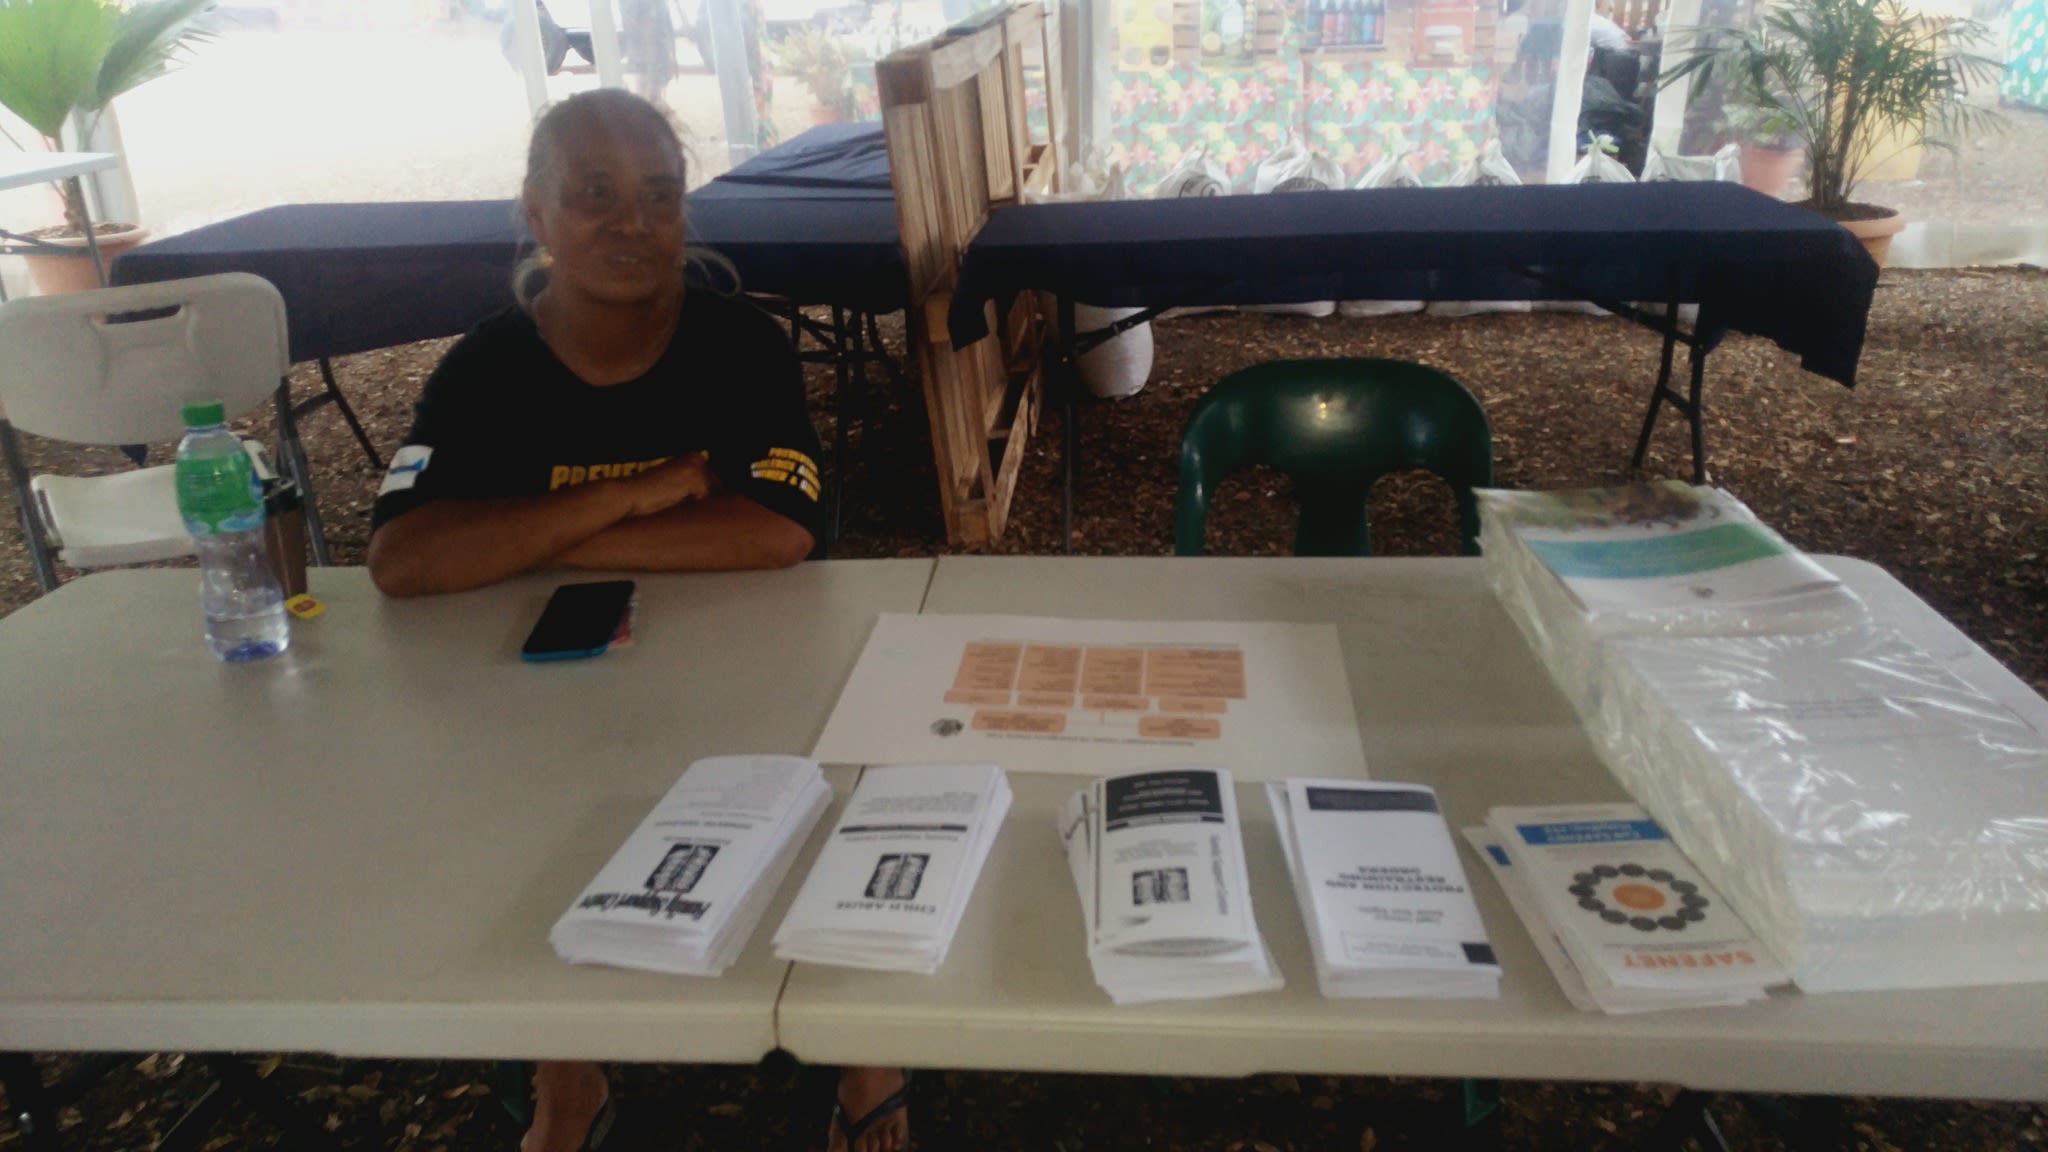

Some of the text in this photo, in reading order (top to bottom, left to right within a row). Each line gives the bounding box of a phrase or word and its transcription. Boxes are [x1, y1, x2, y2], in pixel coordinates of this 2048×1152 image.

[1362, 882, 1465, 894] PROTECTION
[613, 889, 670, 917] Support
[665, 892, 713, 922] Family
[836, 901, 937, 915] CHILD ABUSE
[1624, 950, 1757, 970] SAFENET
